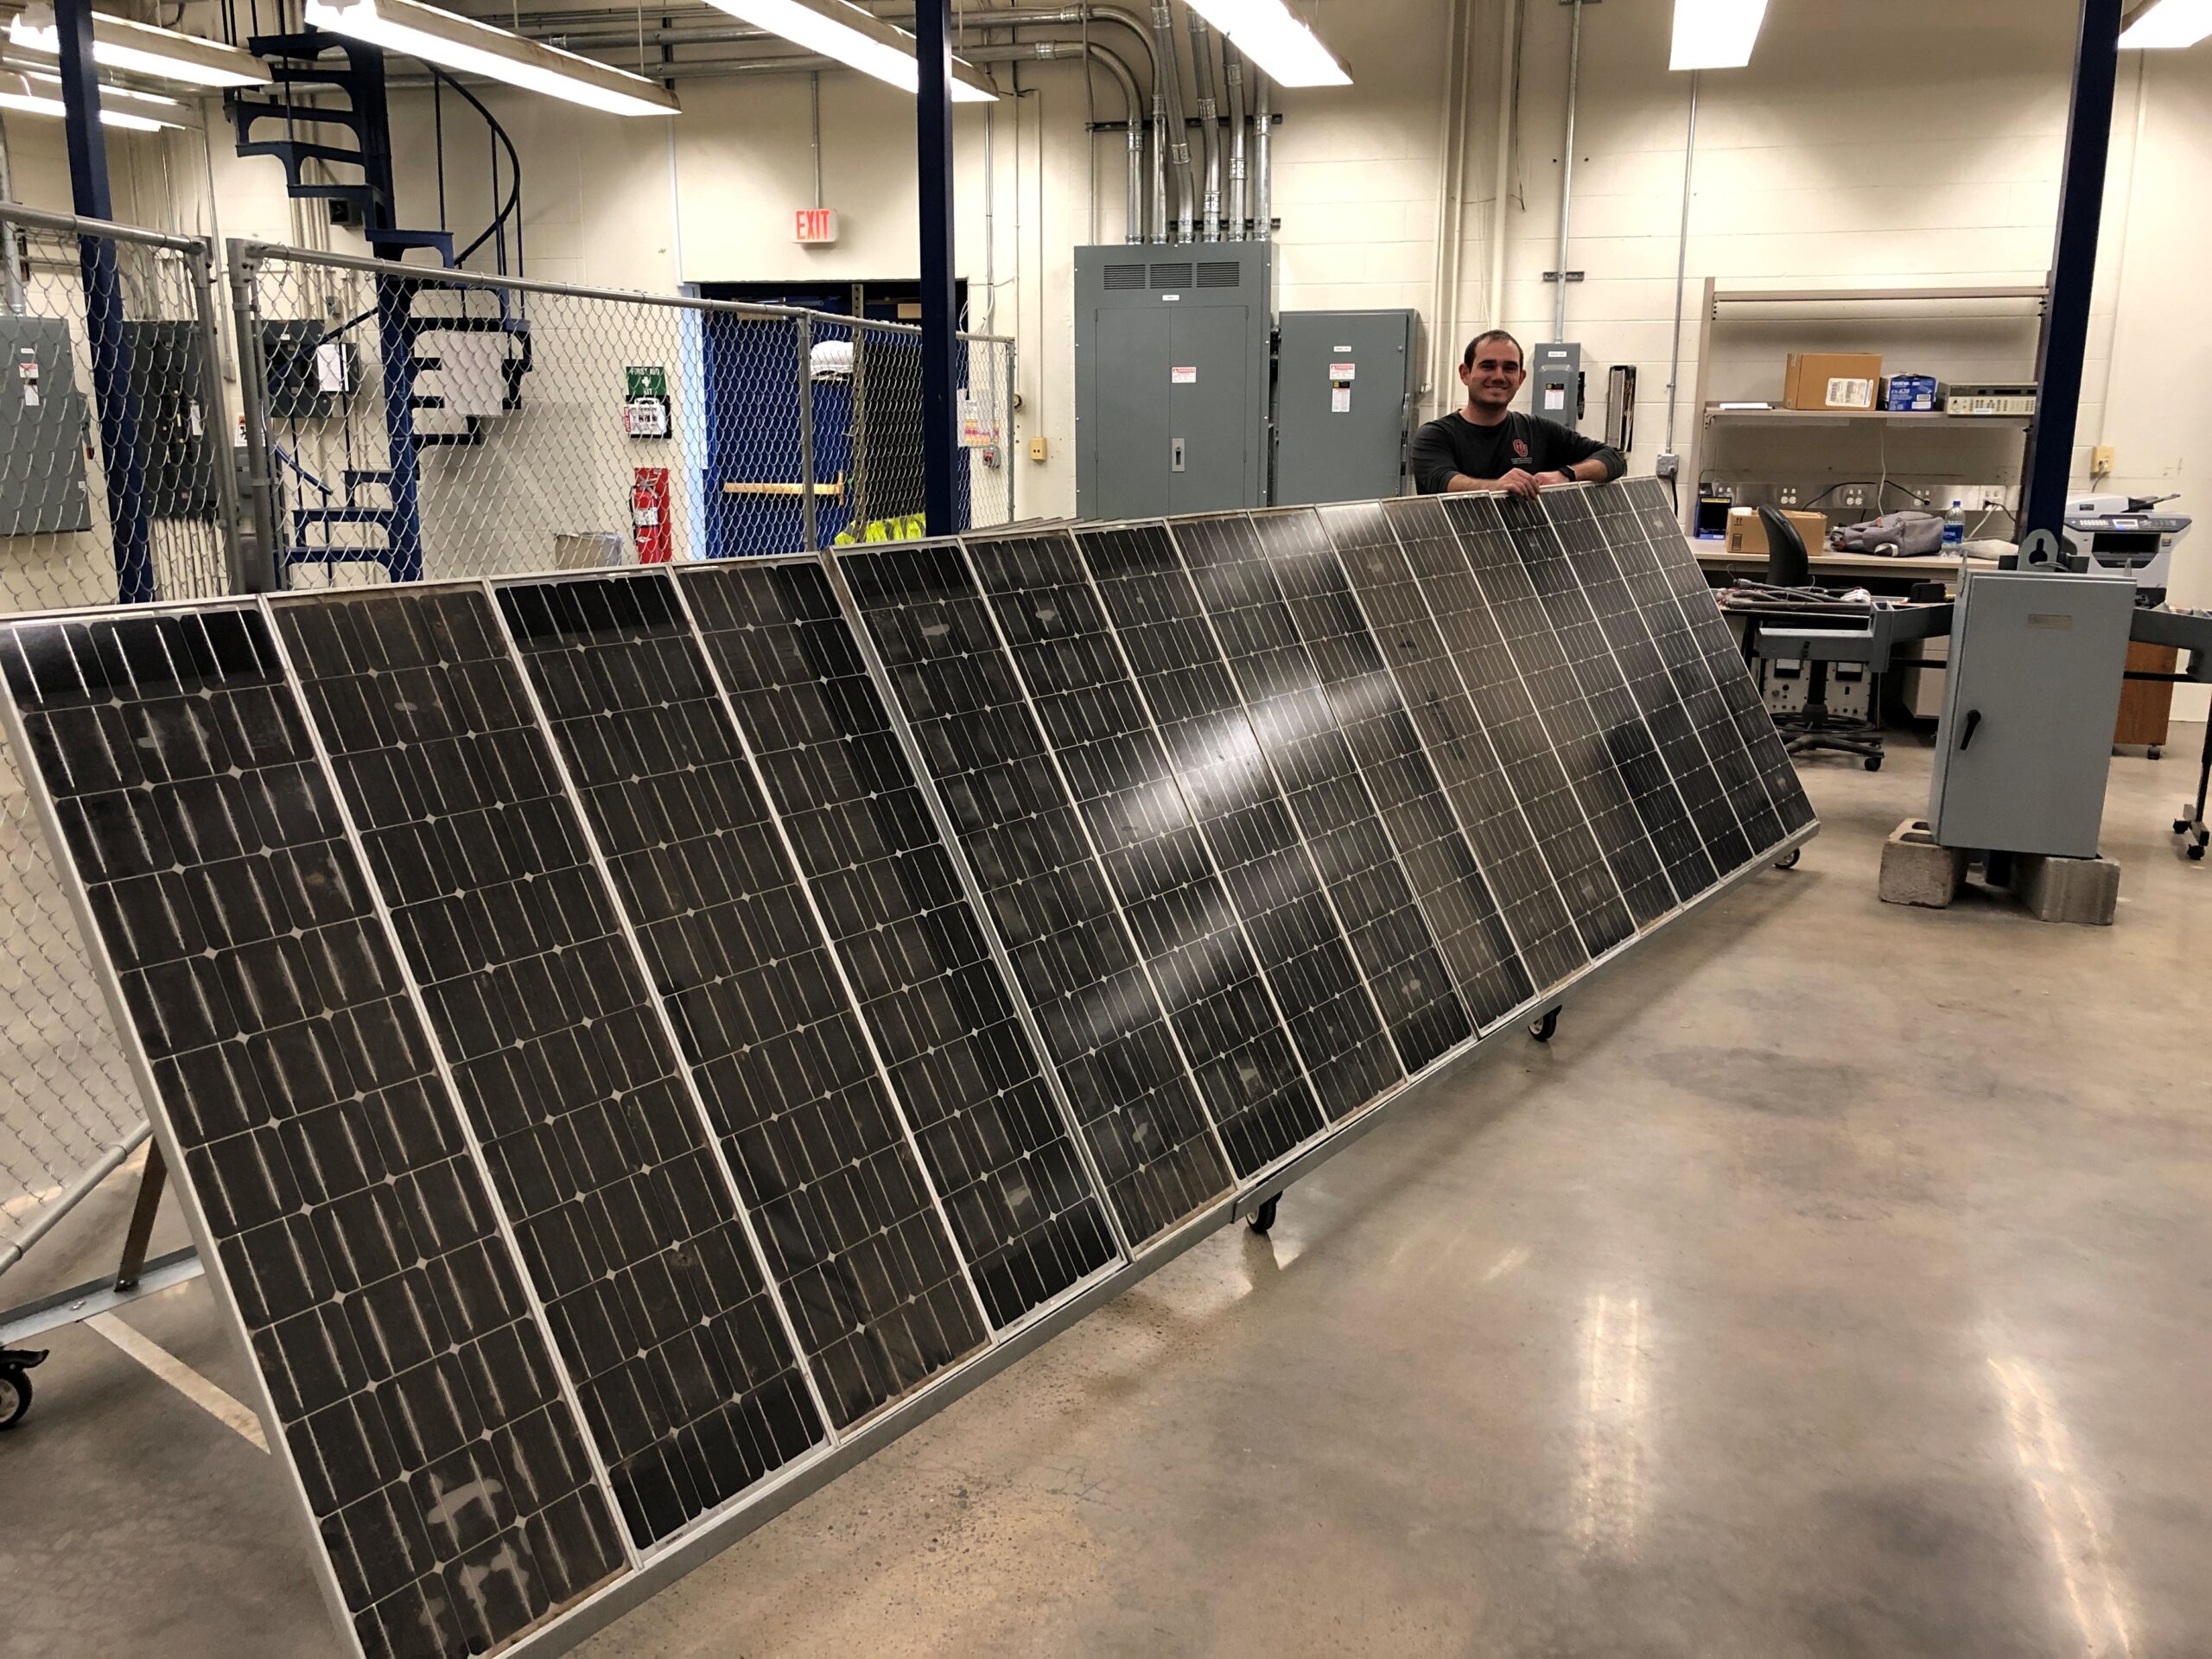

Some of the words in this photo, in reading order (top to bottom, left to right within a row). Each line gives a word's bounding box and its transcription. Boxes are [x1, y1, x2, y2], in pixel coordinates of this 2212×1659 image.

[796, 210, 830, 240] EXIT
[631, 367, 647, 376] FIRST
[650, 367, 660, 376] AID
